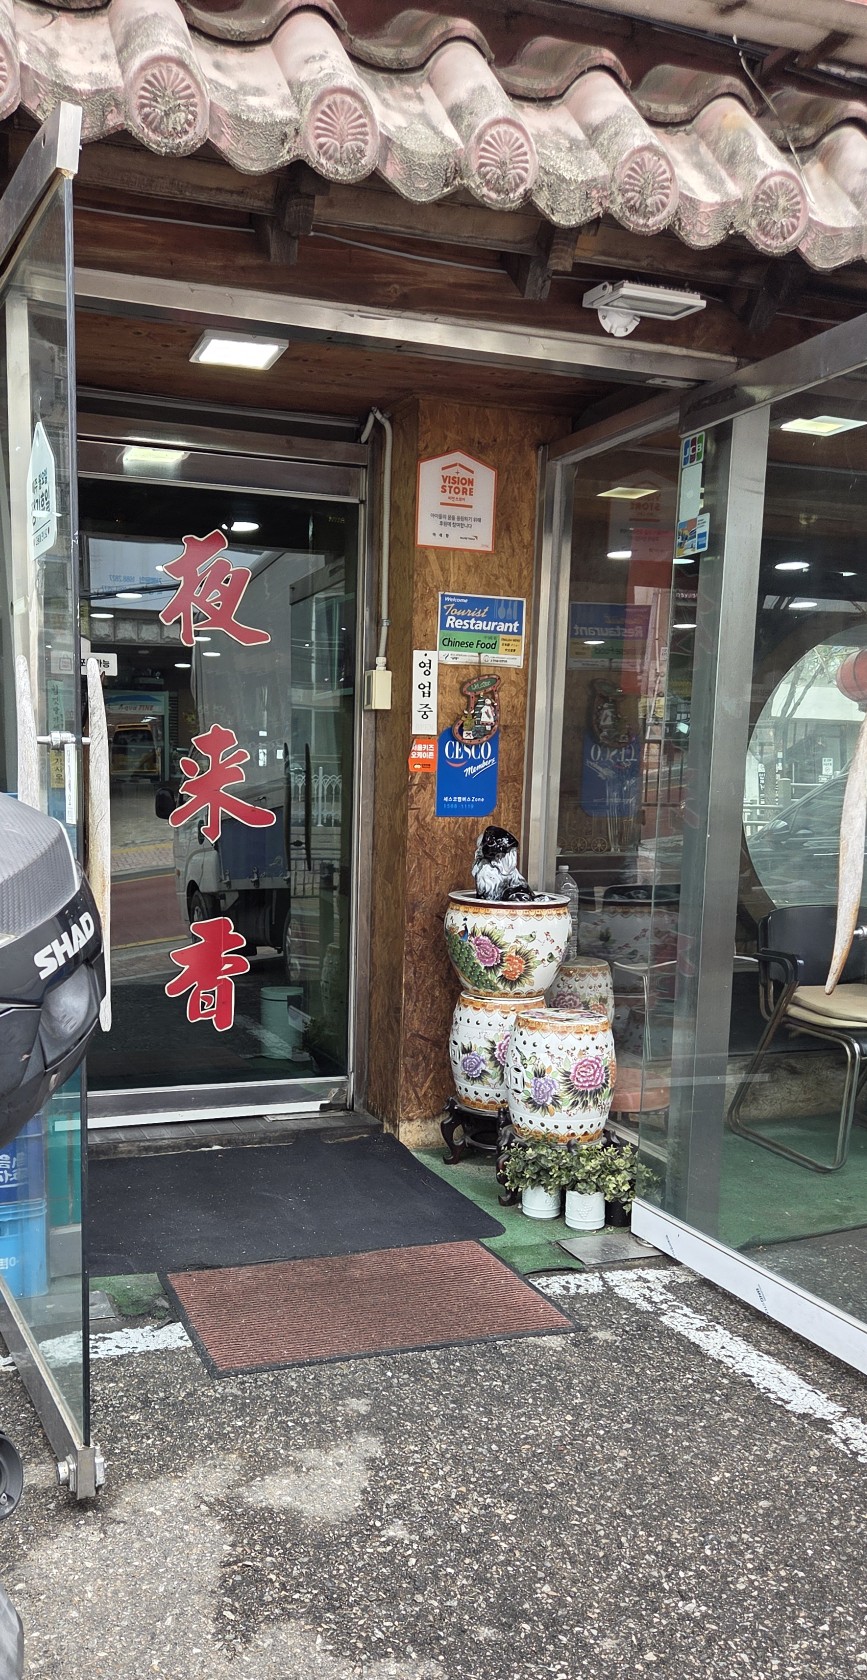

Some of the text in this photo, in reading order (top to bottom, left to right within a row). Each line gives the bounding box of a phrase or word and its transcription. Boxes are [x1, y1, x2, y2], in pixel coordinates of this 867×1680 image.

[684, 442, 703, 458] JCB
[441, 475, 474, 487] VISION
[441, 484, 474, 496] STORE
[443, 603, 489, 618] Tourist
[445, 616, 519, 632] Restaurant
[441, 637, 475, 649] Chinese
[475, 639, 498, 650] Food
[416, 659, 433, 720] 영업중
[445, 740, 491, 760] CESCO
[463, 757, 496, 778] Members
[34, 911, 95, 980] SHAD
